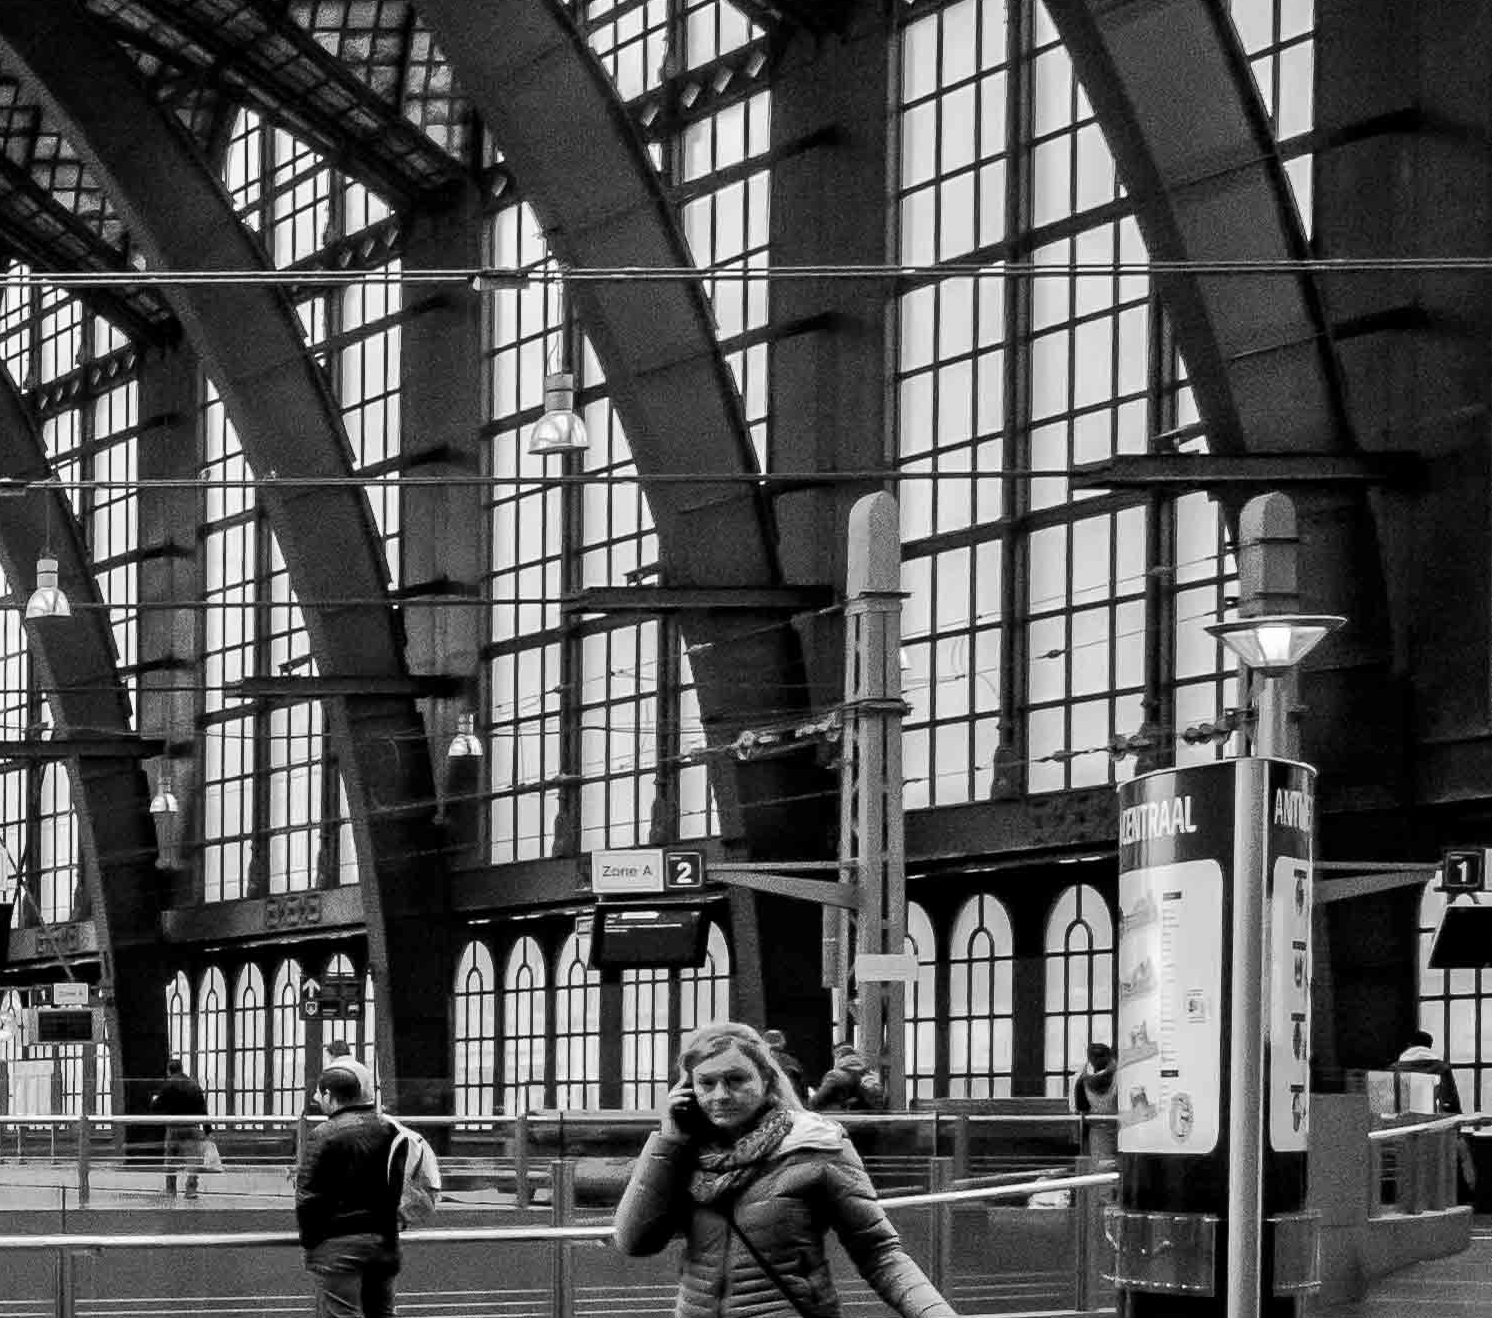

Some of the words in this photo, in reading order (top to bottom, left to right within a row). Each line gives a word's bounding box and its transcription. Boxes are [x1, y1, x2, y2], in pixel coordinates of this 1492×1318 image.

[643, 864, 653, 876] A
[676, 861, 692, 883] 2
[1457, 861, 1467, 882] 1
